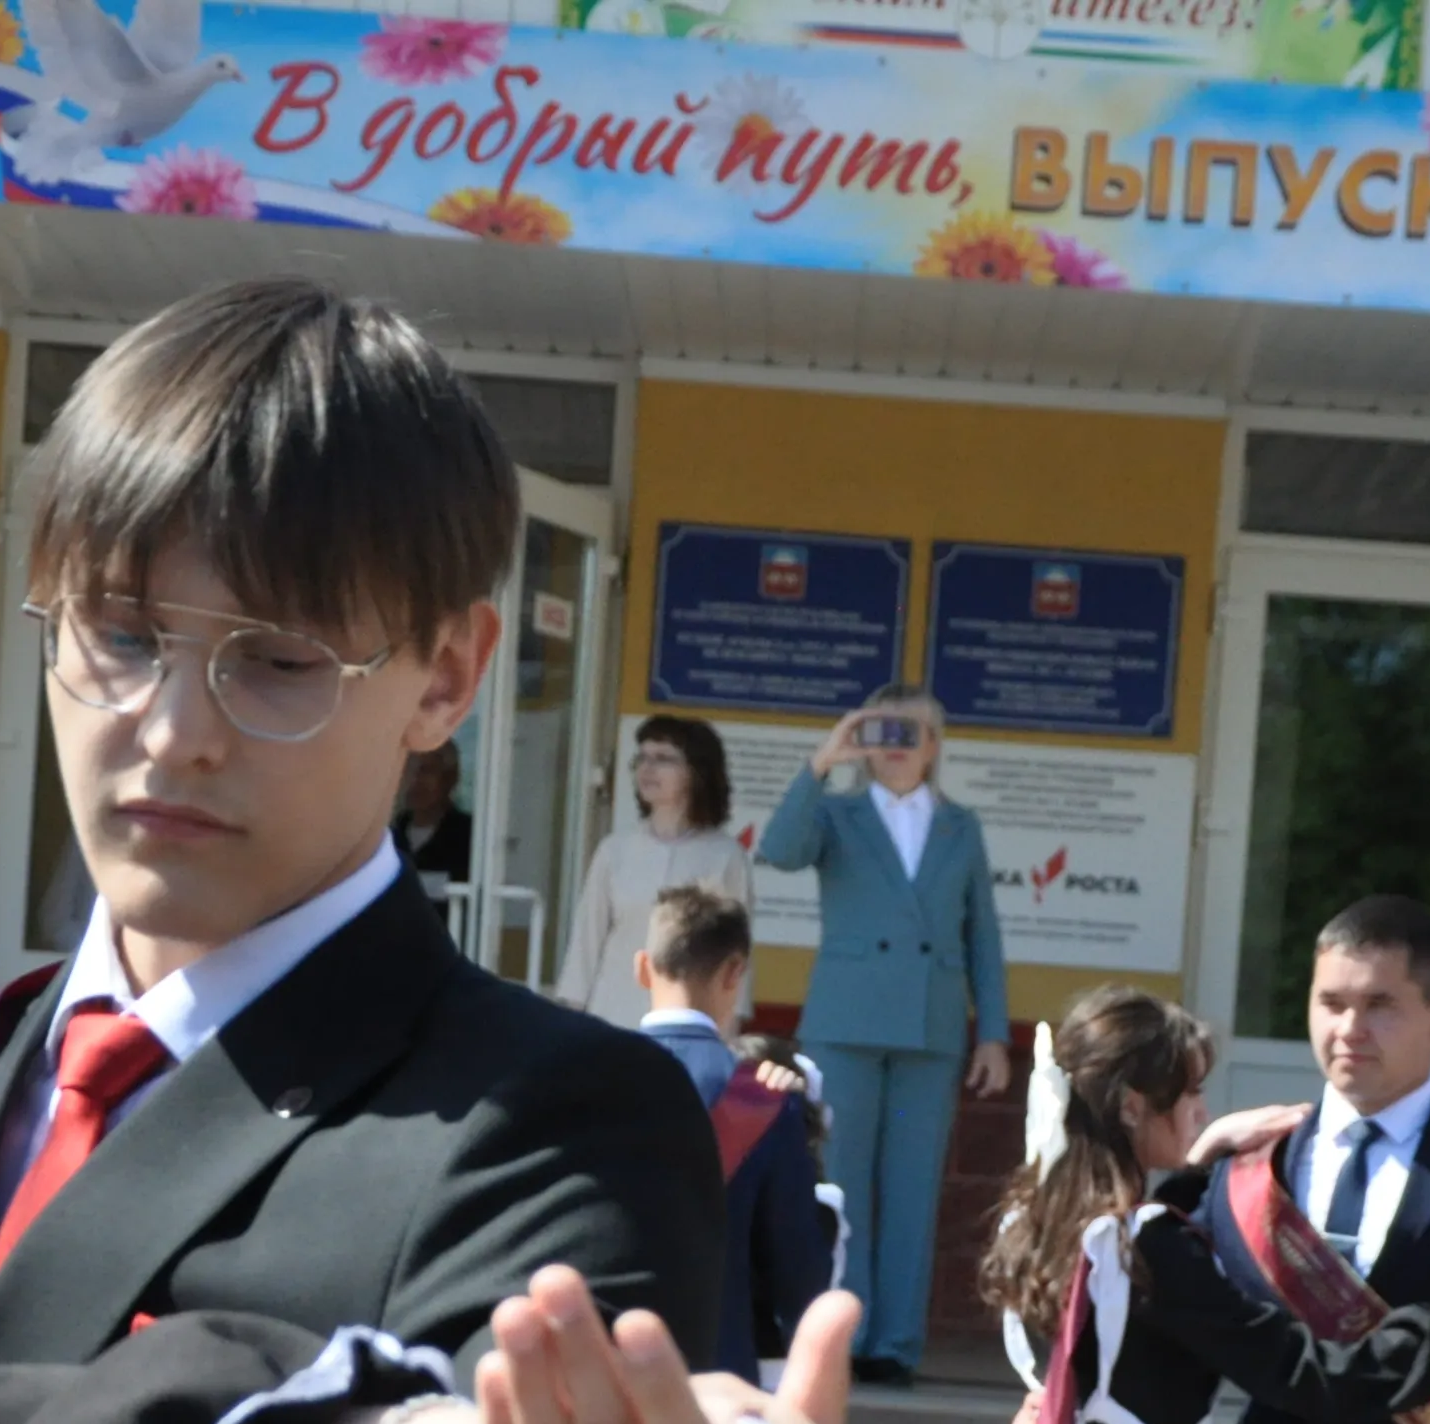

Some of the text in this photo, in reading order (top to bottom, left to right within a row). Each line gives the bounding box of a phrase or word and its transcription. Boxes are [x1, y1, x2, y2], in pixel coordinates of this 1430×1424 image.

[253, 60, 340, 152] В
[330, 64, 711, 204] добрый
[716, 126, 974, 224] путь,
[1065, 873, 1140, 895] РОСТА
